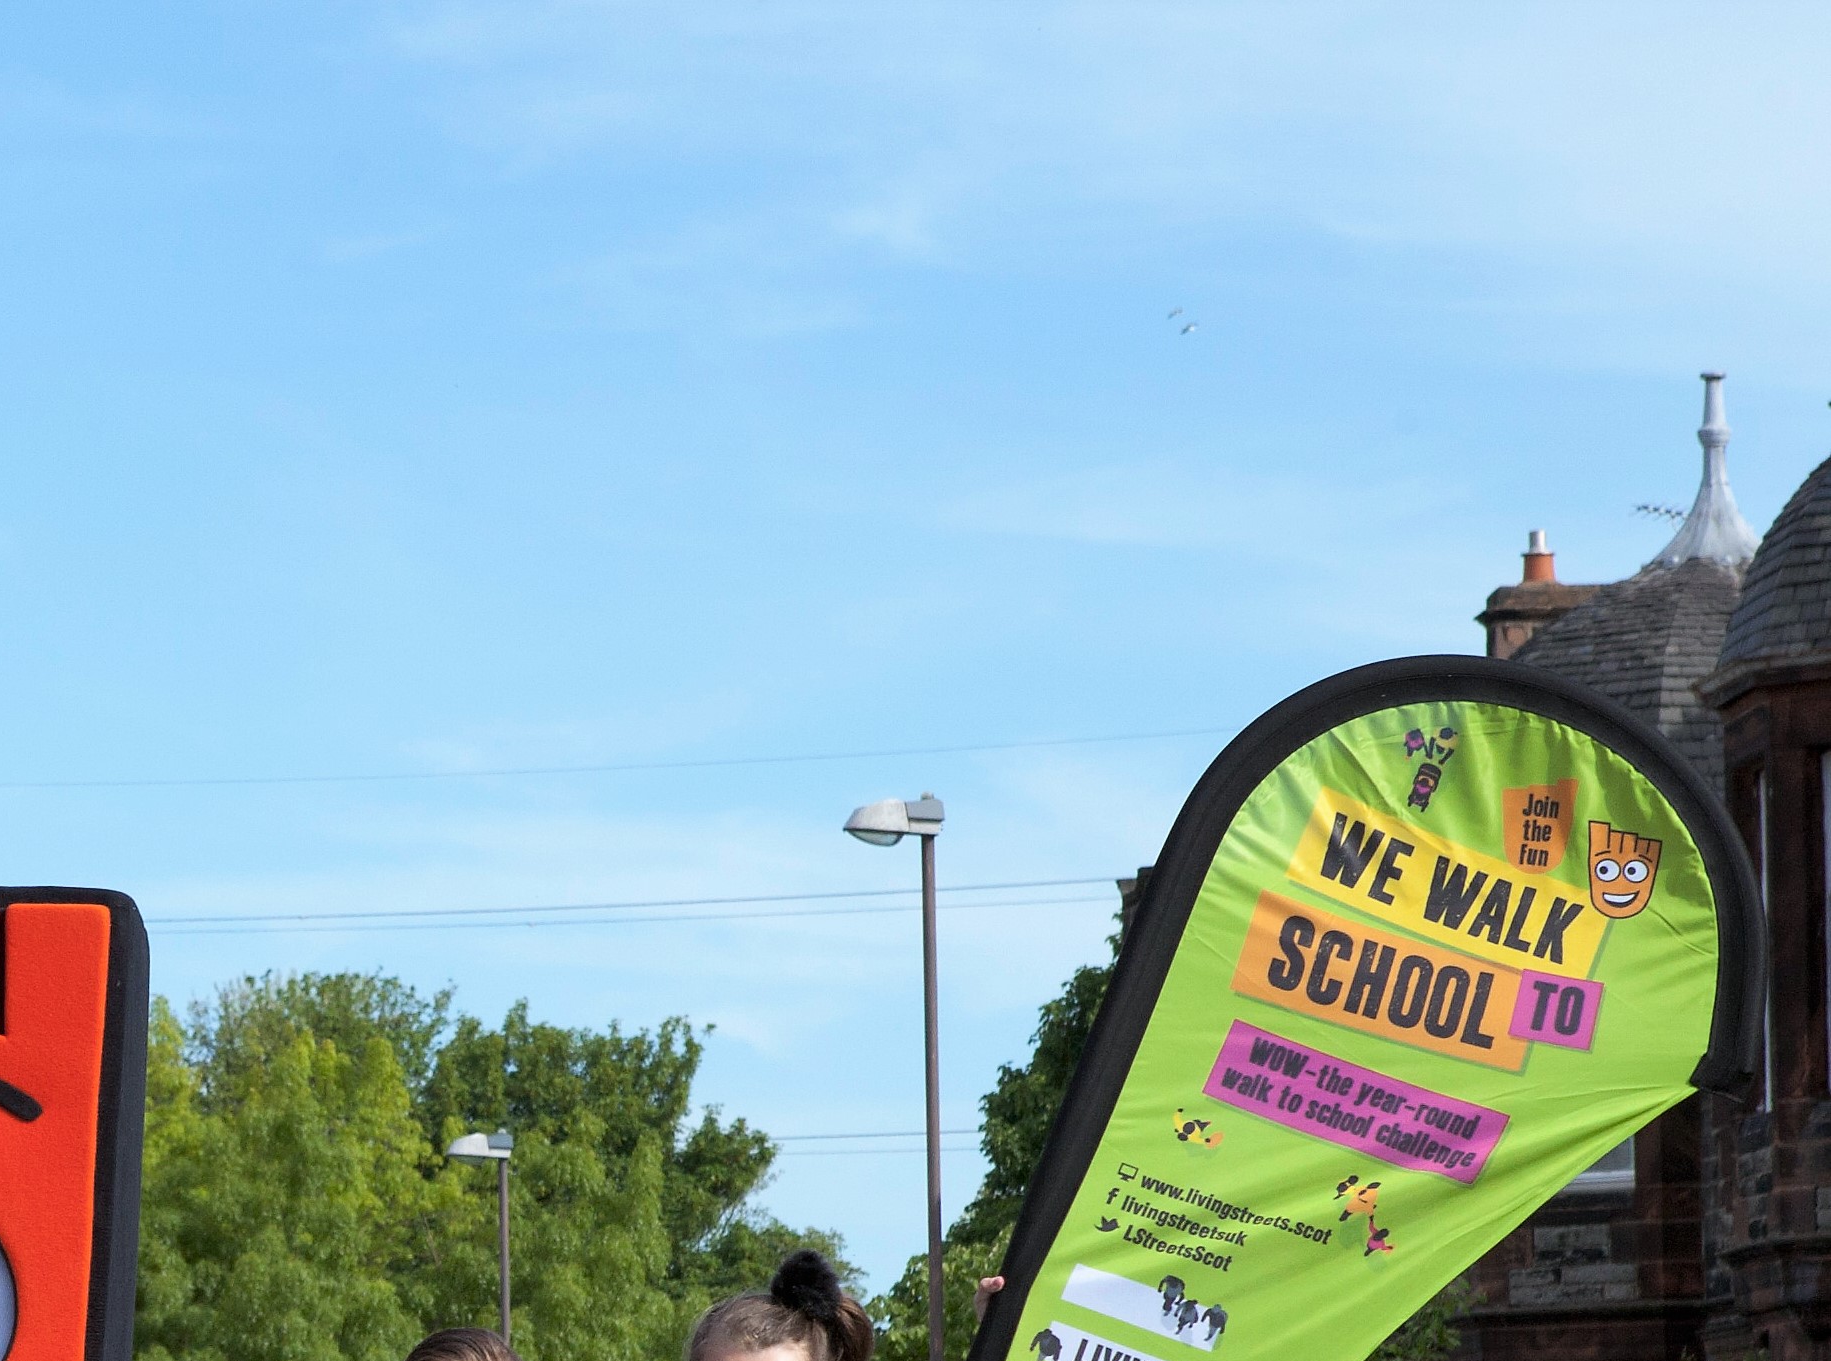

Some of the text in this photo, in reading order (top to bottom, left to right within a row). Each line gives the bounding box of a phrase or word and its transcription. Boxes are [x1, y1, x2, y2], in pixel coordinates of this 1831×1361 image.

[1523, 794, 1560, 819] Join
[1523, 819, 1551, 842] the
[1321, 812, 1584, 964] WE WALK
[1268, 915, 1585, 1049] SCHOOL TO
[1222, 1068, 1475, 1168] walk to school challenge
[1354, 1083, 1482, 1140] year-round
[1121, 1195, 1247, 1246] livingstreetsuk
[1141, 1176, 1332, 1245] www.livingstreets.scot
[1123, 1225, 1232, 1271] LStreetsScot
